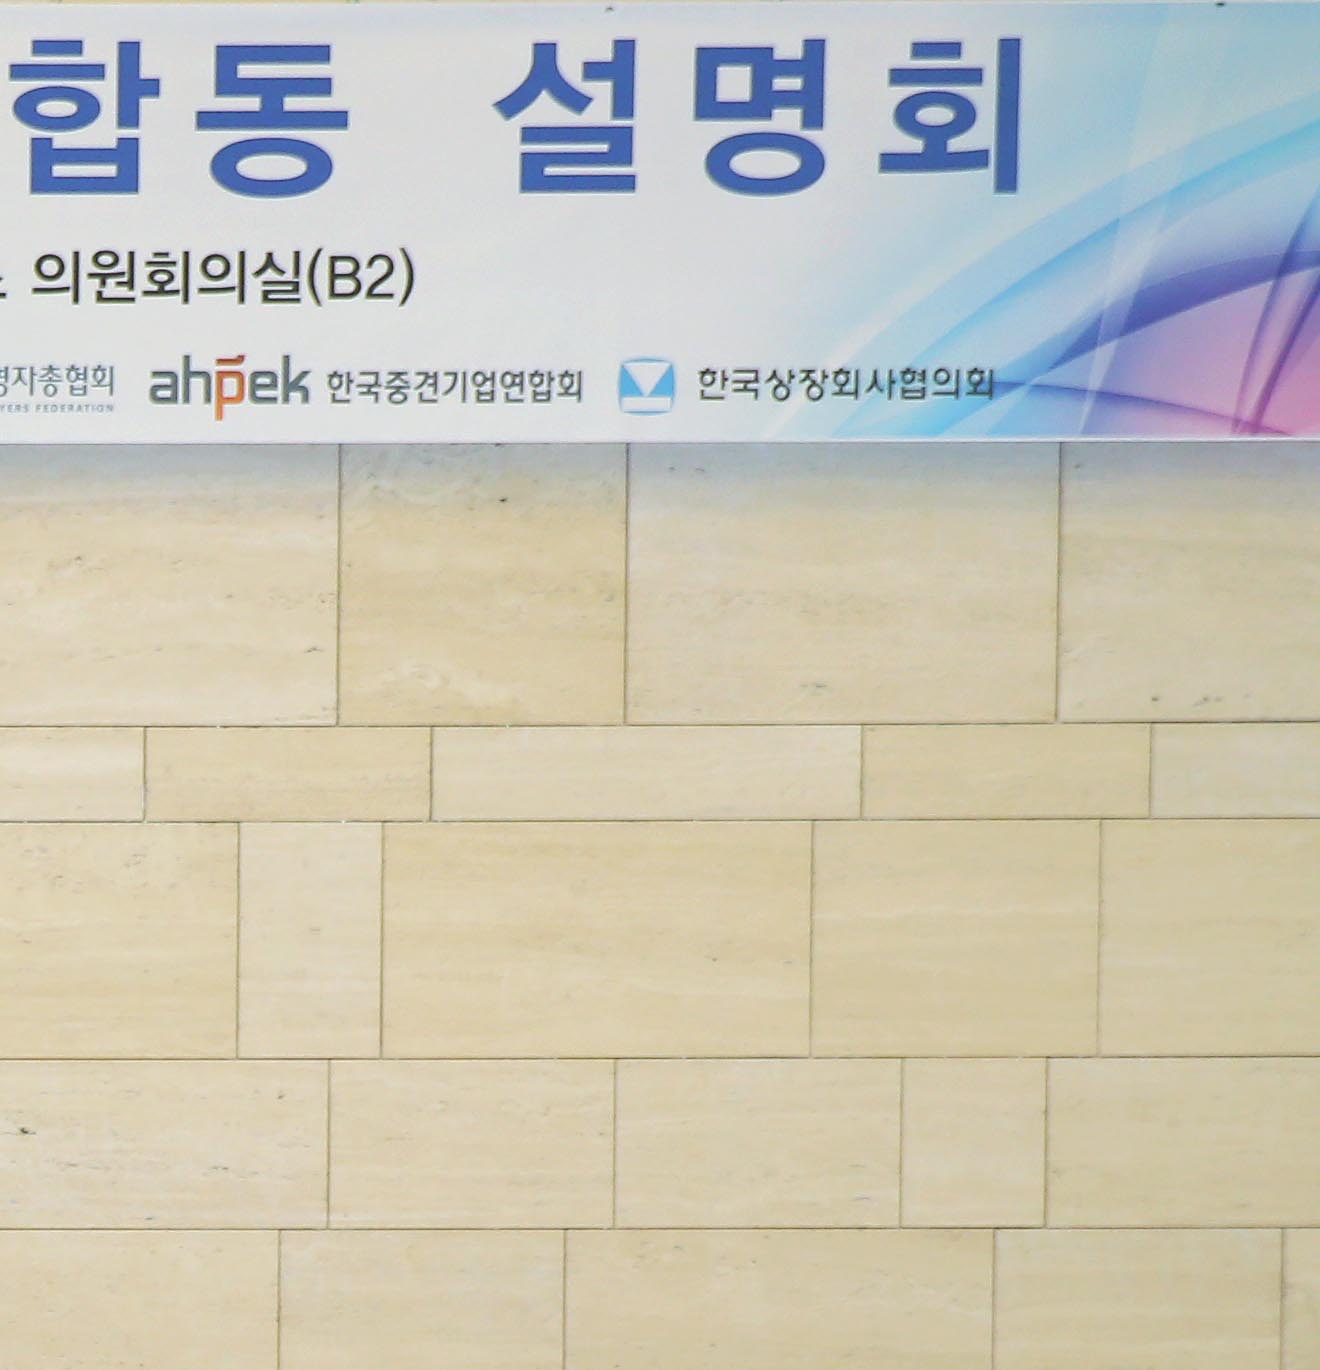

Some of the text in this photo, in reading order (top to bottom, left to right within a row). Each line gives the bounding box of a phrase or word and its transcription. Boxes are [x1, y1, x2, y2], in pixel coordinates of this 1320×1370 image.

[493, 36, 1023, 199] 설명회
[33, 247, 417, 309] 의원회의실(B2)
[36, 404, 115, 414] FEDERATION
[150, 355, 312, 421] ahpek
[327, 369, 585, 407] 한국중견기업연합회
[698, 367, 996, 404] 한국상장회사협의회
